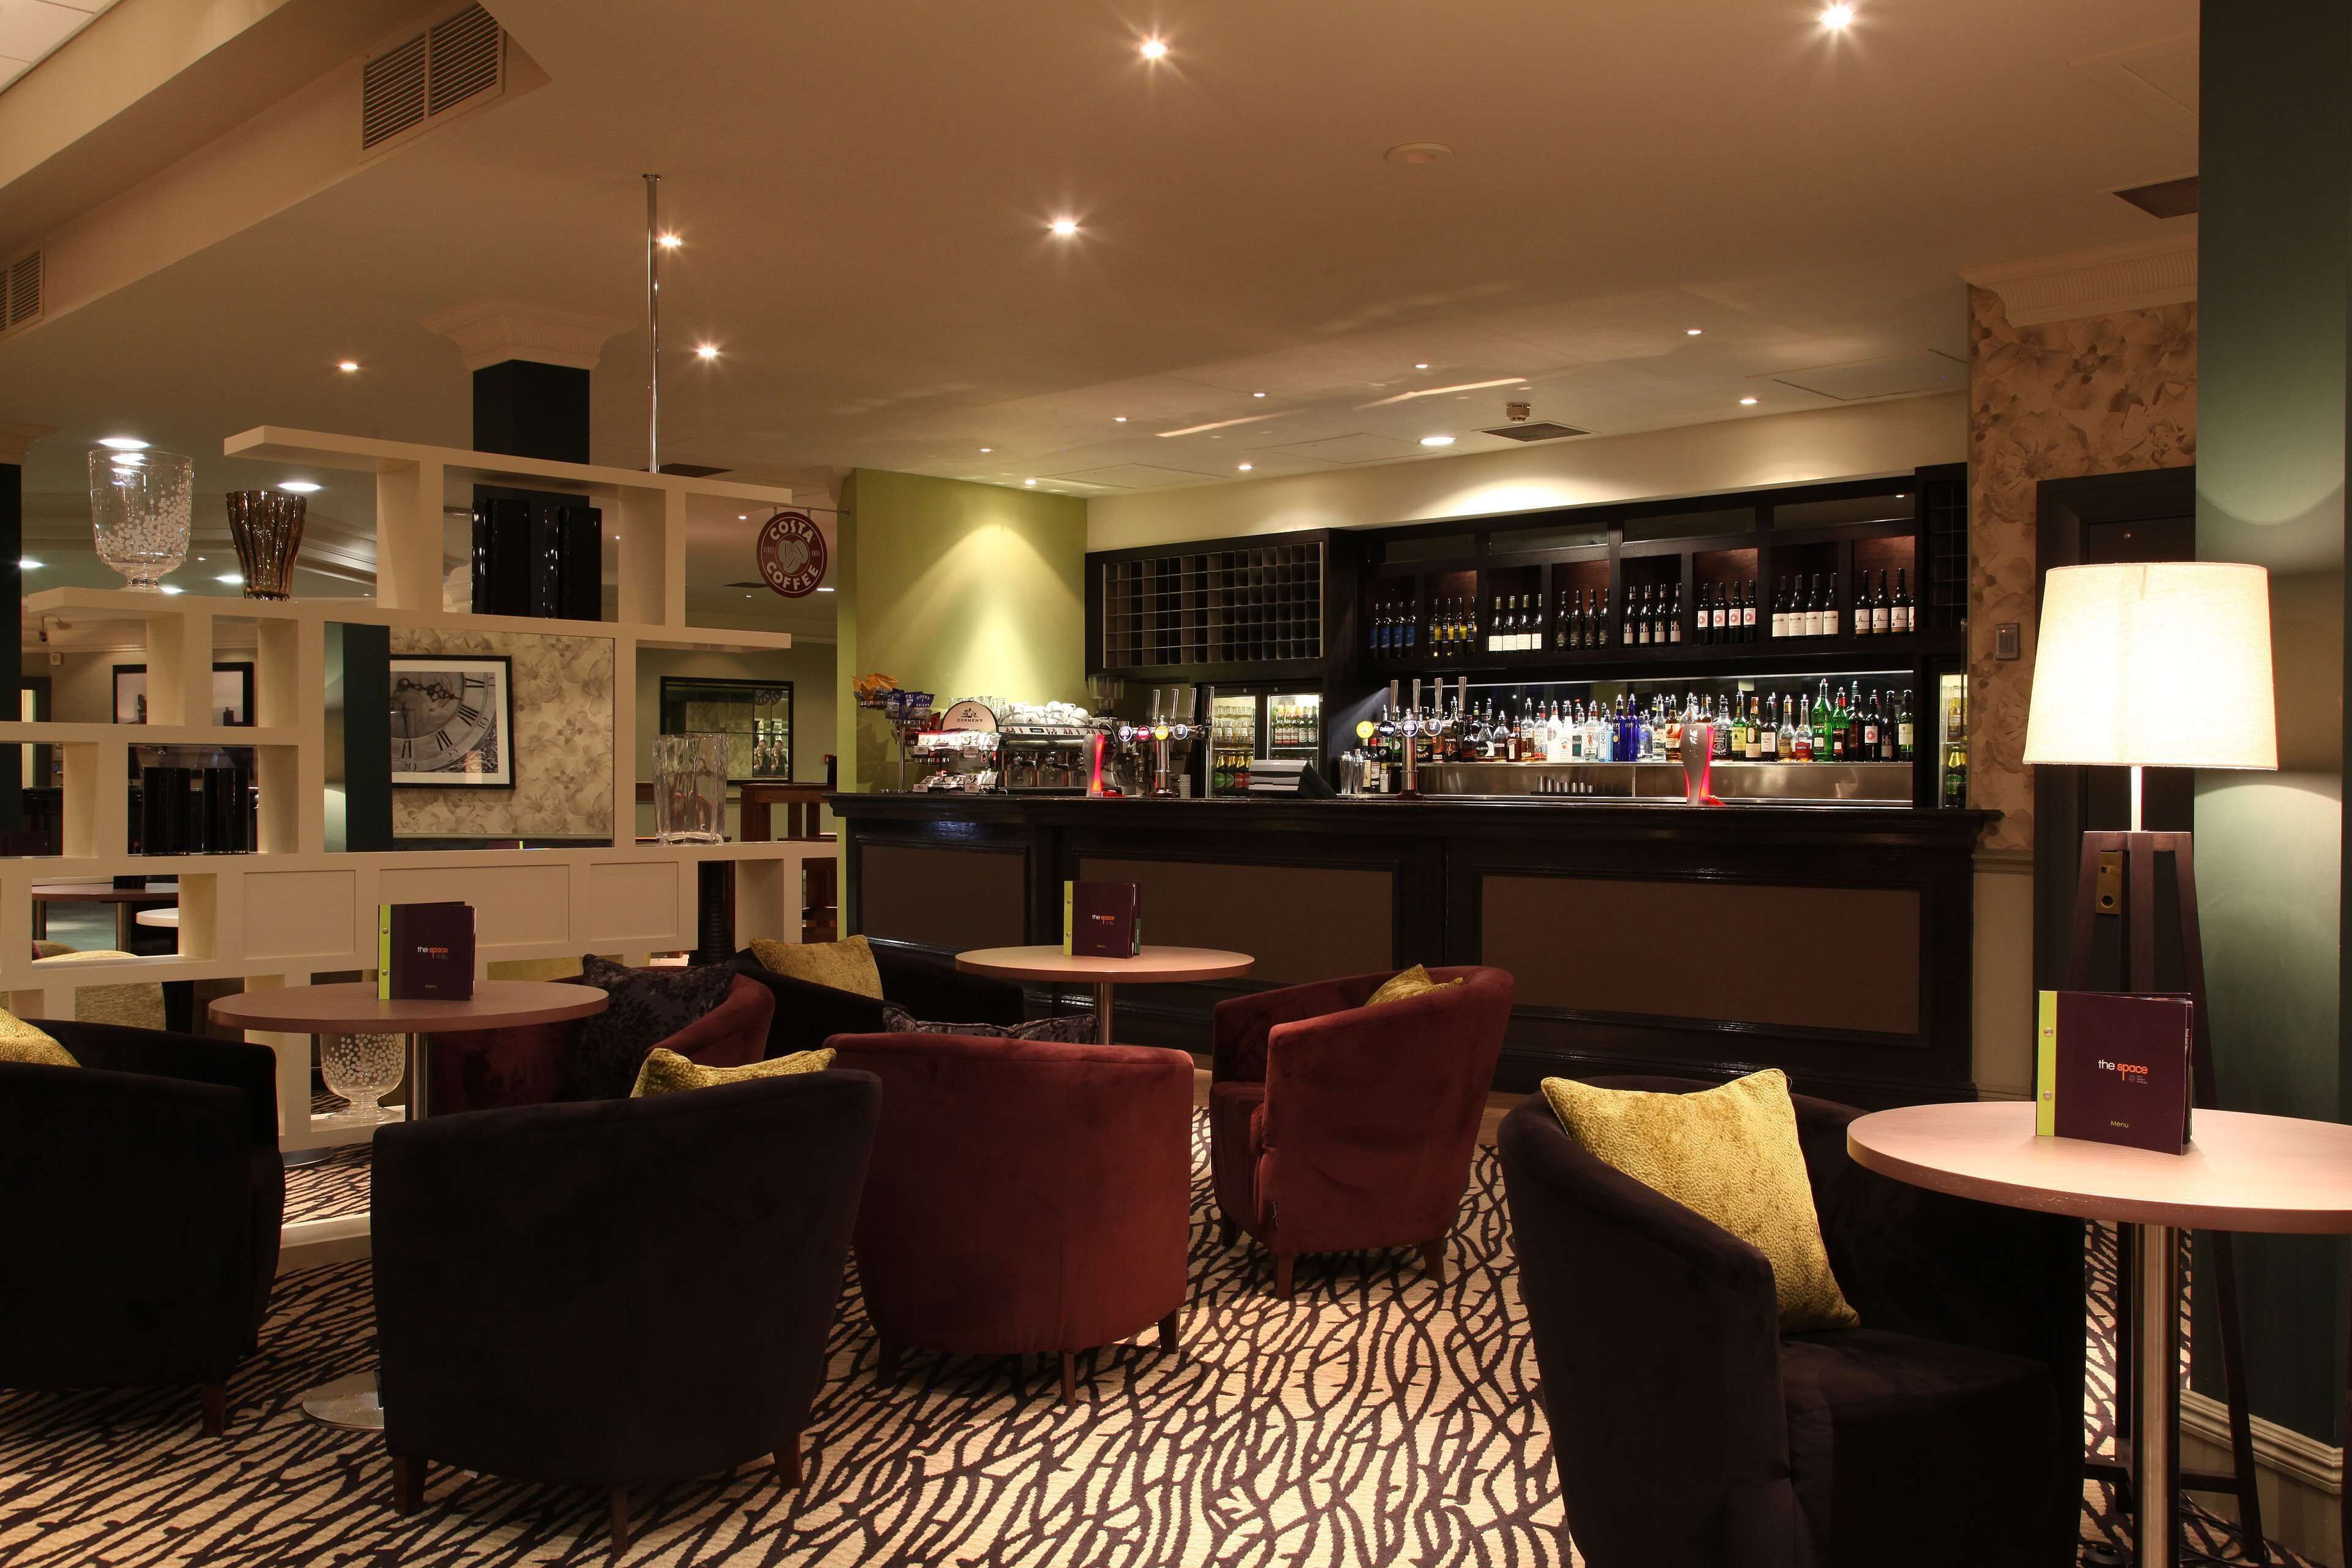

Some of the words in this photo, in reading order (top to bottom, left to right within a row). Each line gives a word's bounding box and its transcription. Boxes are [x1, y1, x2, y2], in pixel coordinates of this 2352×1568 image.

[770, 520, 814, 543] COSTA
[766, 562, 819, 590] COFFEE
[1101, 916, 1115, 925] space
[429, 947, 448, 959] space
[2098, 1059, 2115, 1071] the
[2117, 1063, 2148, 1081] space
